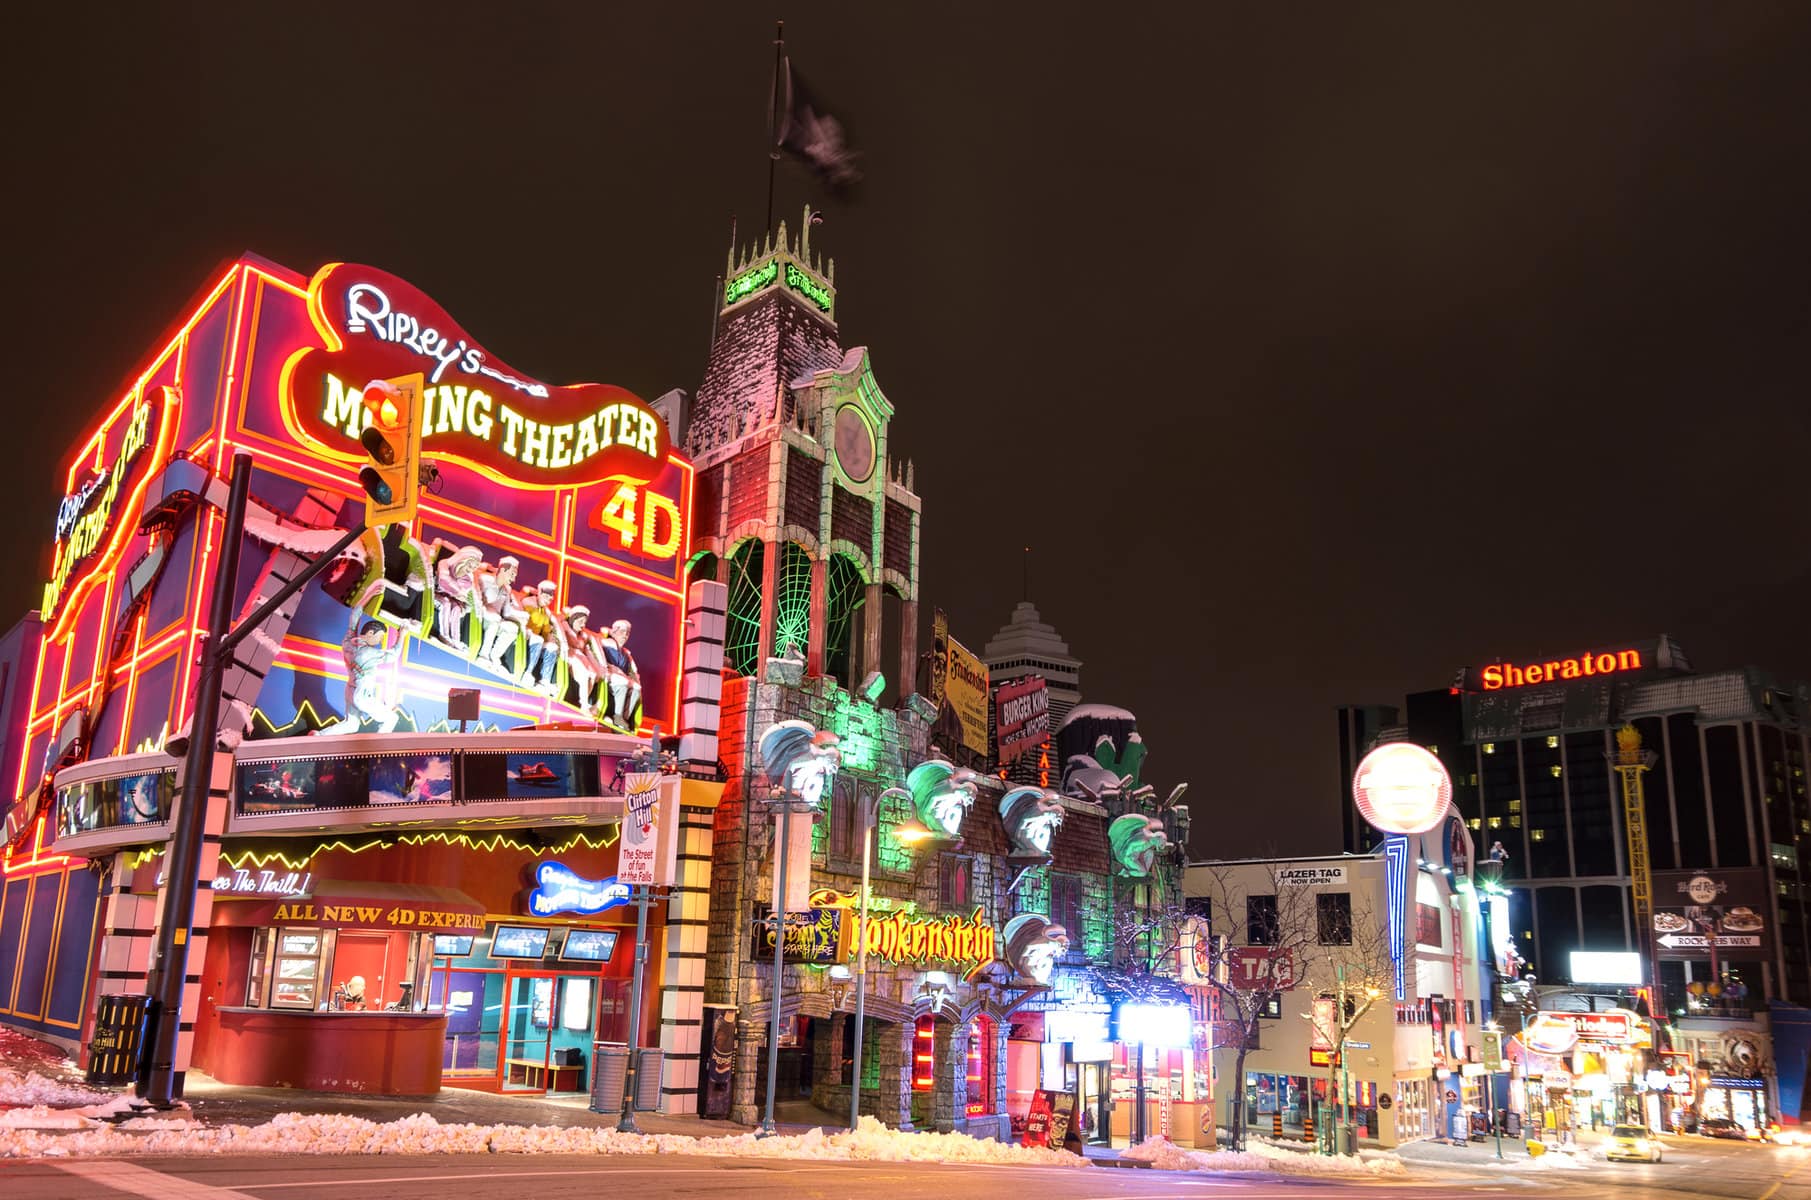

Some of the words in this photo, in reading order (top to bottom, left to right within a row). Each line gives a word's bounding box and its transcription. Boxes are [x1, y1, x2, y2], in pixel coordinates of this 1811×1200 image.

[323, 372, 493, 441] MING
[500, 403, 658, 470] THEATER
[600, 480, 683, 559] 4D
[1483, 650, 1642, 690] Sheraton
[1003, 695, 1033, 726] BURGER
[1031, 687, 1049, 713] KING
[627, 788, 658, 812] Clifton
[635, 803, 652, 827] Hill
[623, 849, 634, 859] The
[634, 848, 653, 859] Street
[628, 860, 635, 870] of
[635, 860, 646, 871] fun
[627, 871, 639, 880] the
[638, 871, 652, 882] Falls
[1280, 869, 1317, 879] LAZER
[1318, 868, 1342, 877] TAG
[273, 904, 318, 921] ALL
[321, 905, 383, 924] NEW
[386, 907, 416, 926] 4D
[849, 905, 995, 983] rankenstein
[1679, 937, 1705, 945] ROCK
[1729, 937, 1752, 945] WAY
[1241, 956, 1291, 981] TAG
